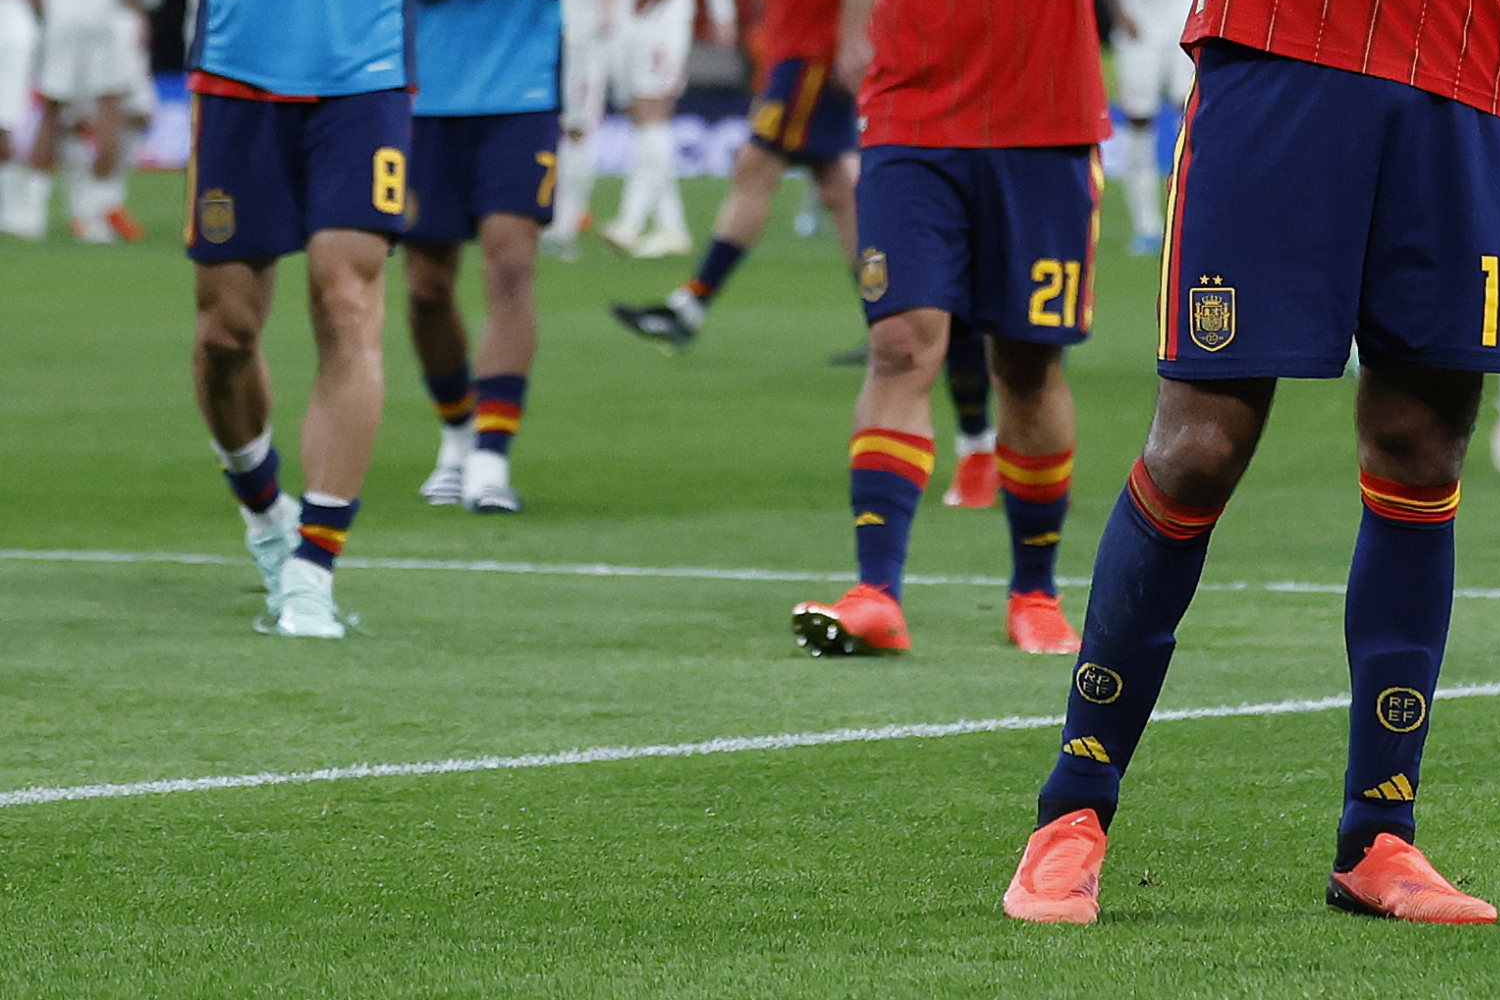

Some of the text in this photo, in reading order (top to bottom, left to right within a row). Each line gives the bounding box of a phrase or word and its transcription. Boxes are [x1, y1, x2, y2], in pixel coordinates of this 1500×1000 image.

[372, 146, 407, 215] 8
[534, 151, 558, 208] 7
[1028, 257, 1081, 328] 21
